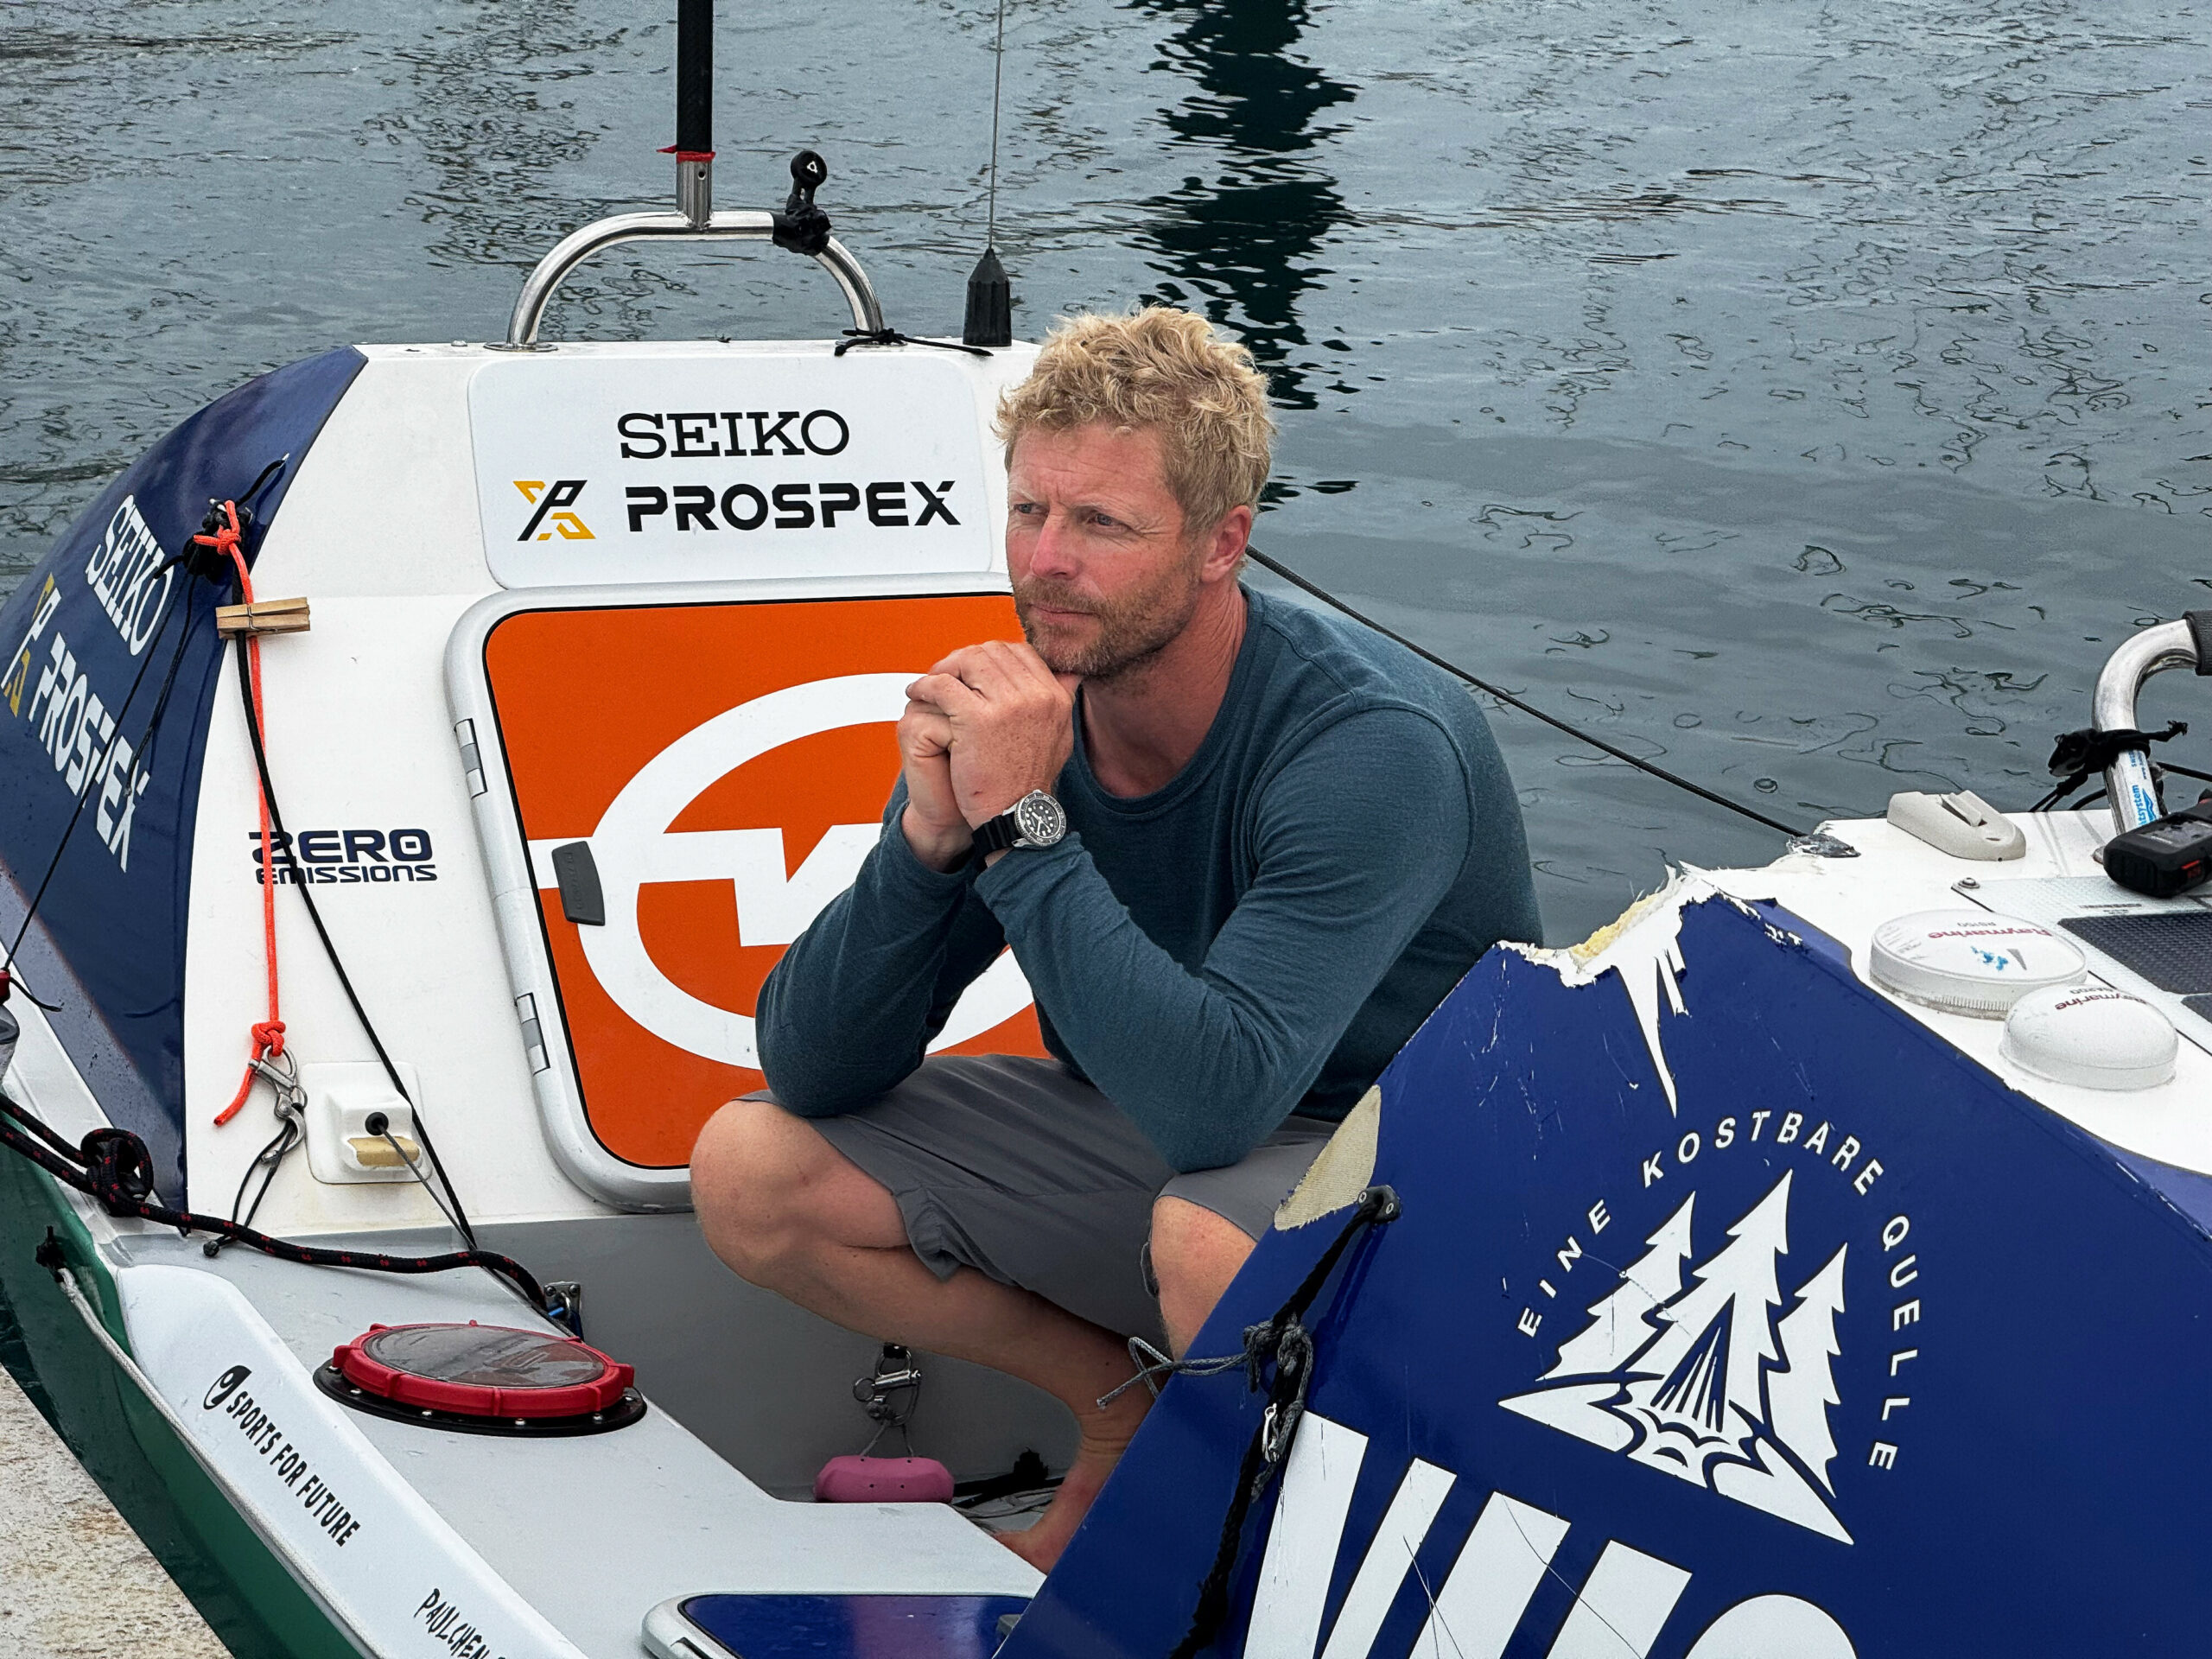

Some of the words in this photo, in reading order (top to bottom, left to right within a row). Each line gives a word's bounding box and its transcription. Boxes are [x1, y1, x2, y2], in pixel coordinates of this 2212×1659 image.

[617, 410, 849, 459] SEIKO
[625, 480, 961, 532] PROSPEX
[86, 494, 174, 656] SEIKO
[28, 632, 149, 873] PROSPEX
[2132, 785, 2147, 826] tsystem
[248, 829, 433, 865] ZERO
[1928, 927, 2053, 939] Raymarine
[1517, 1199, 1611, 1338] EINE
[1642, 1110, 1885, 1196] KOSTBARE
[1868, 1215, 1920, 1471] QUELLE
[226, 1391, 283, 1455] SPORTS
[270, 1443, 306, 1488] FOR
[296, 1475, 361, 1548] FUTURE
